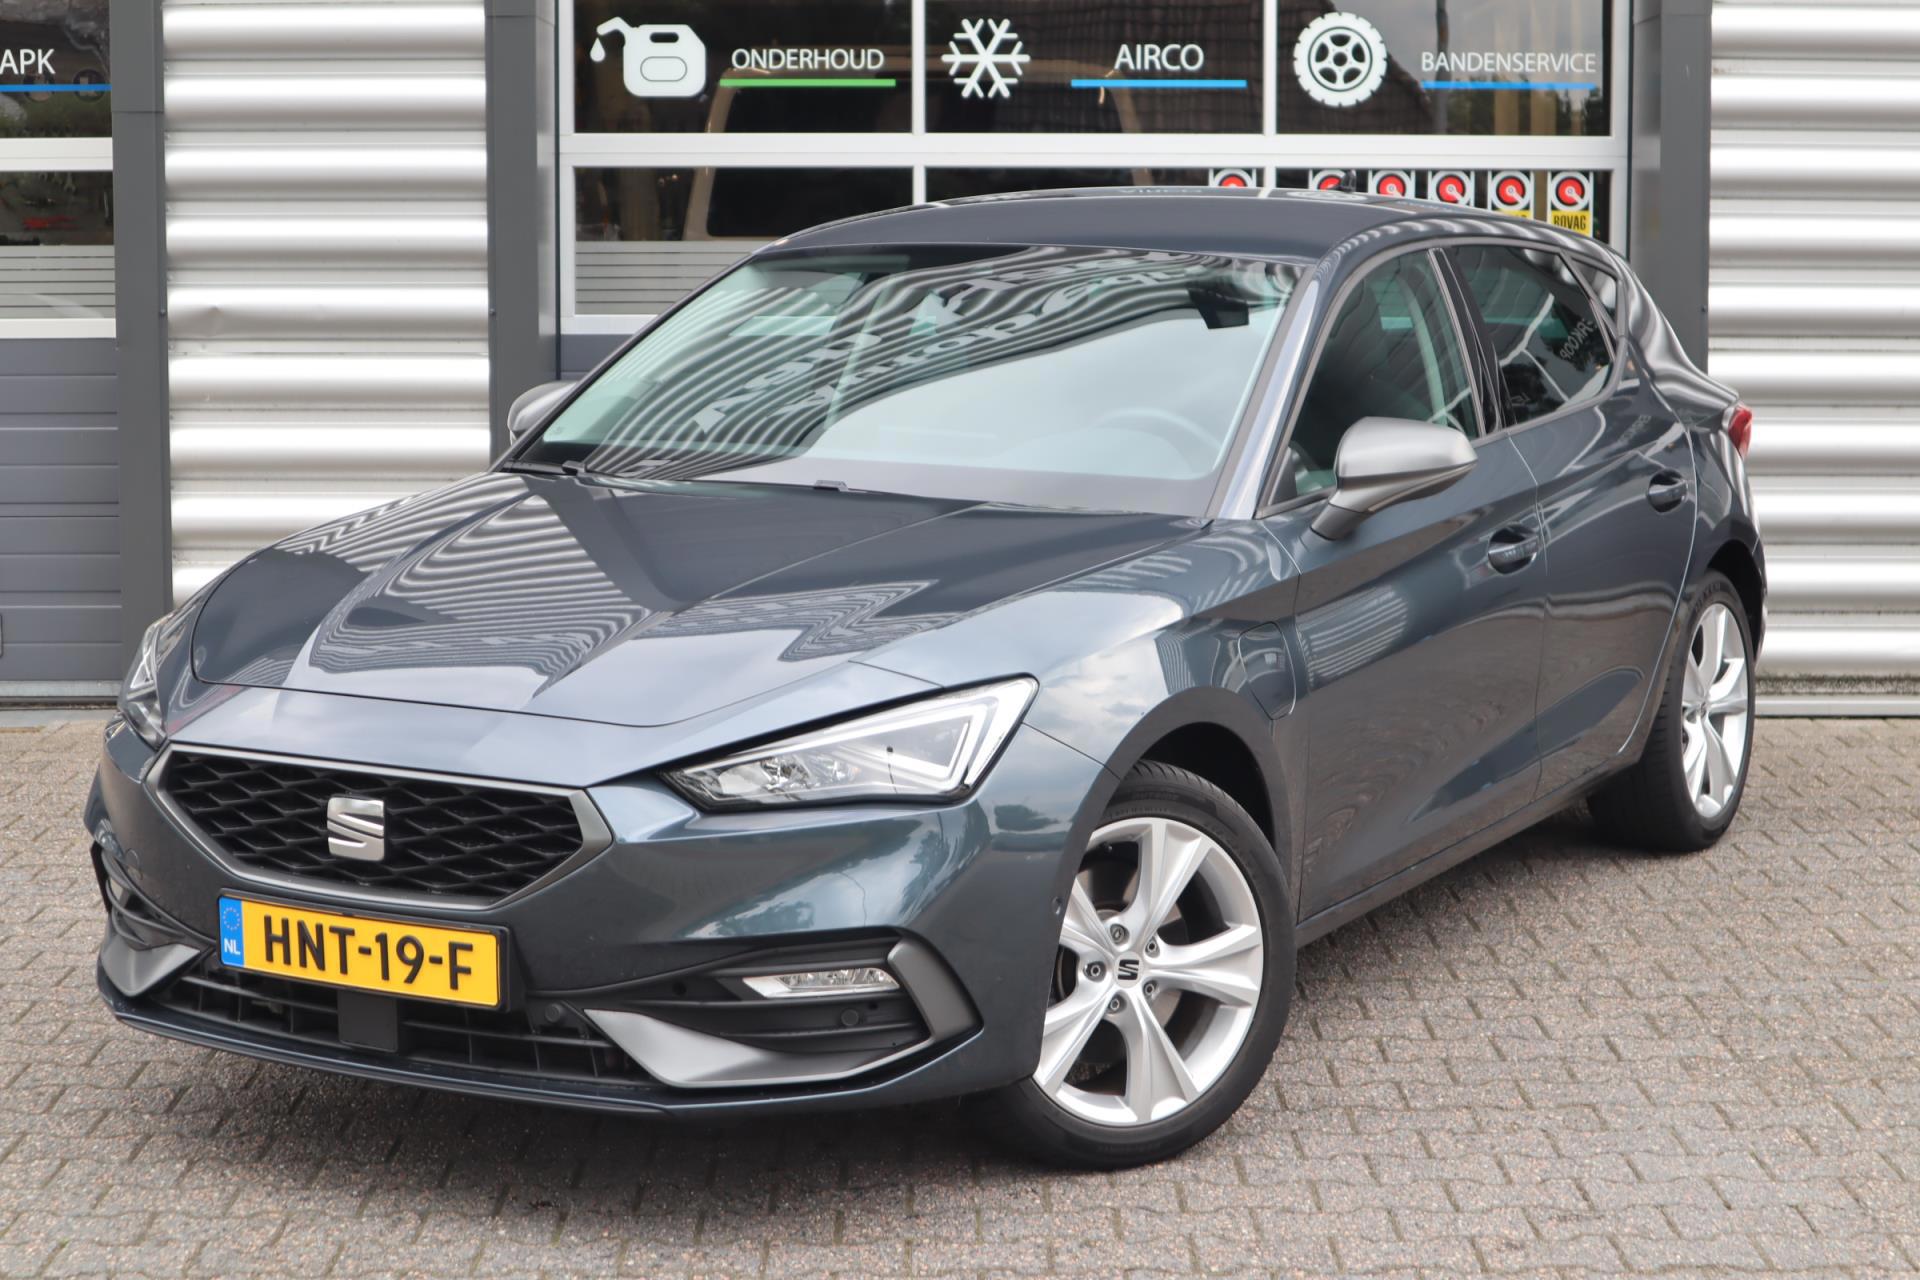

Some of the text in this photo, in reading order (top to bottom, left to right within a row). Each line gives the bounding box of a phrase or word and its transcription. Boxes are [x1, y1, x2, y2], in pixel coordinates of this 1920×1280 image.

[0, 48, 56, 75] APK
[731, 48, 885, 71] ONDERHOUD
[1114, 43, 1205, 72] AIRCO
[1421, 52, 1597, 73] BANDENSERVICE
[224, 937, 241, 956] NL
[263, 914, 474, 991] HNT-19-F
